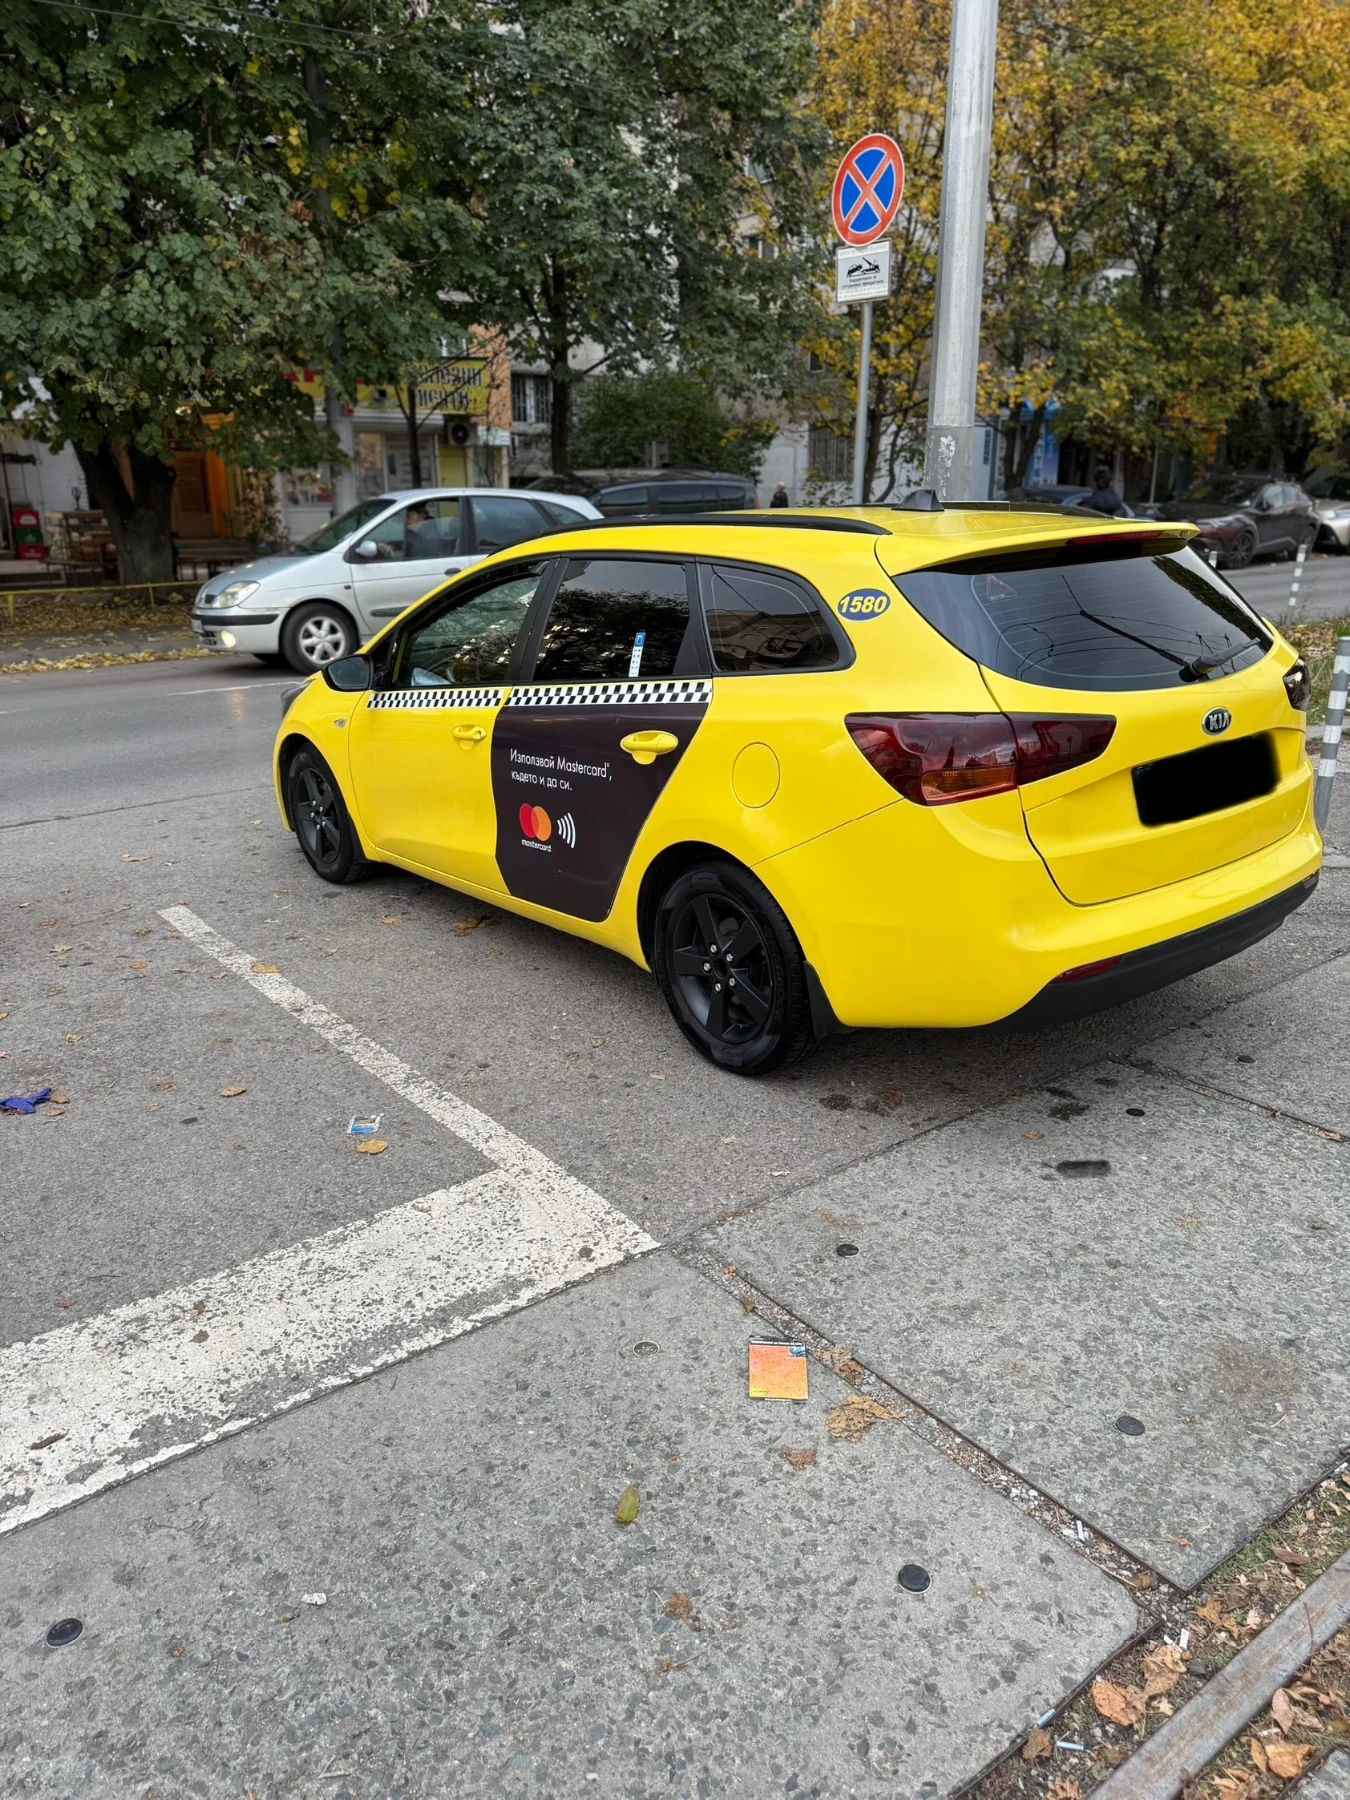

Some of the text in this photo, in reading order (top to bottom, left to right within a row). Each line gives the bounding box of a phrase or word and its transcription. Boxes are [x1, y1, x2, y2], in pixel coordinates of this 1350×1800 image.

[840, 596, 887, 613] 1580
[1208, 712, 1229, 730] KIA
[510, 747, 555, 770] Използвай
[511, 770, 573, 792] където и да си.
[521, 838, 552, 853] mastercard
